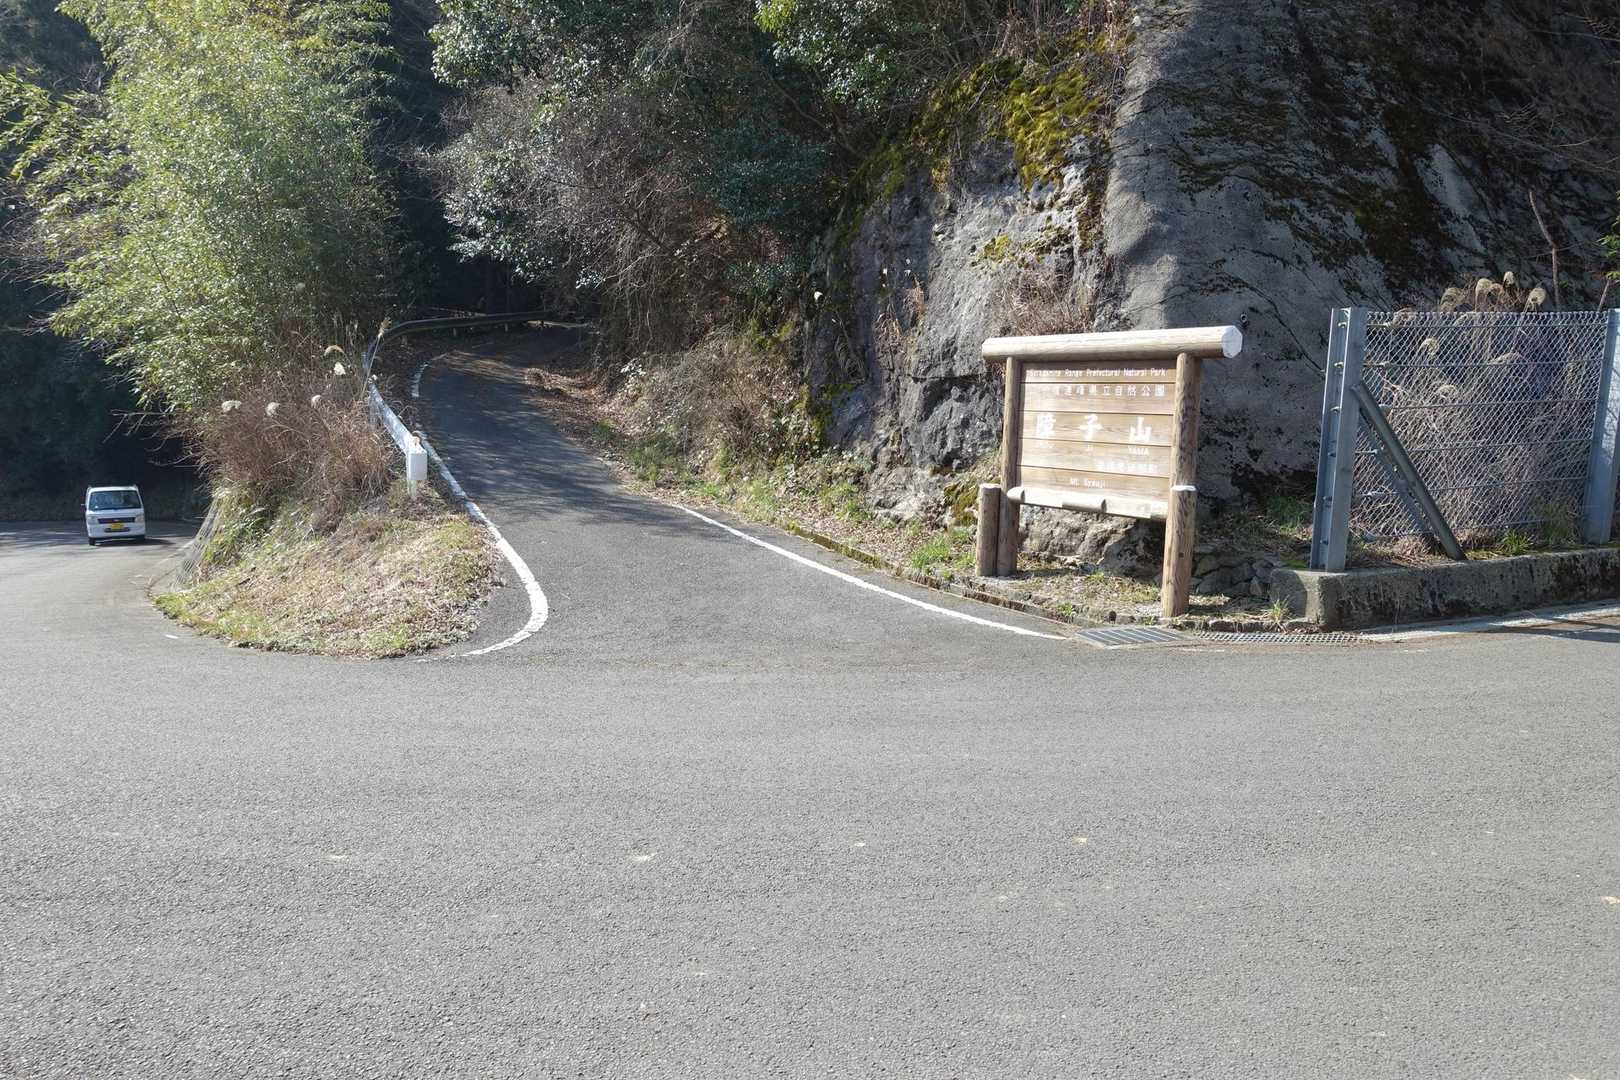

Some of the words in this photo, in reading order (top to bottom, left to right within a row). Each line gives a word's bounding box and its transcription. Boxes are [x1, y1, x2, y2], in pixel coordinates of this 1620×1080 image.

[1065, 369, 1082, 378] Range
[1086, 369, 1120, 377] Prefectural
[1124, 369, 1147, 377] Natural
[1150, 369, 1166, 377] Park
